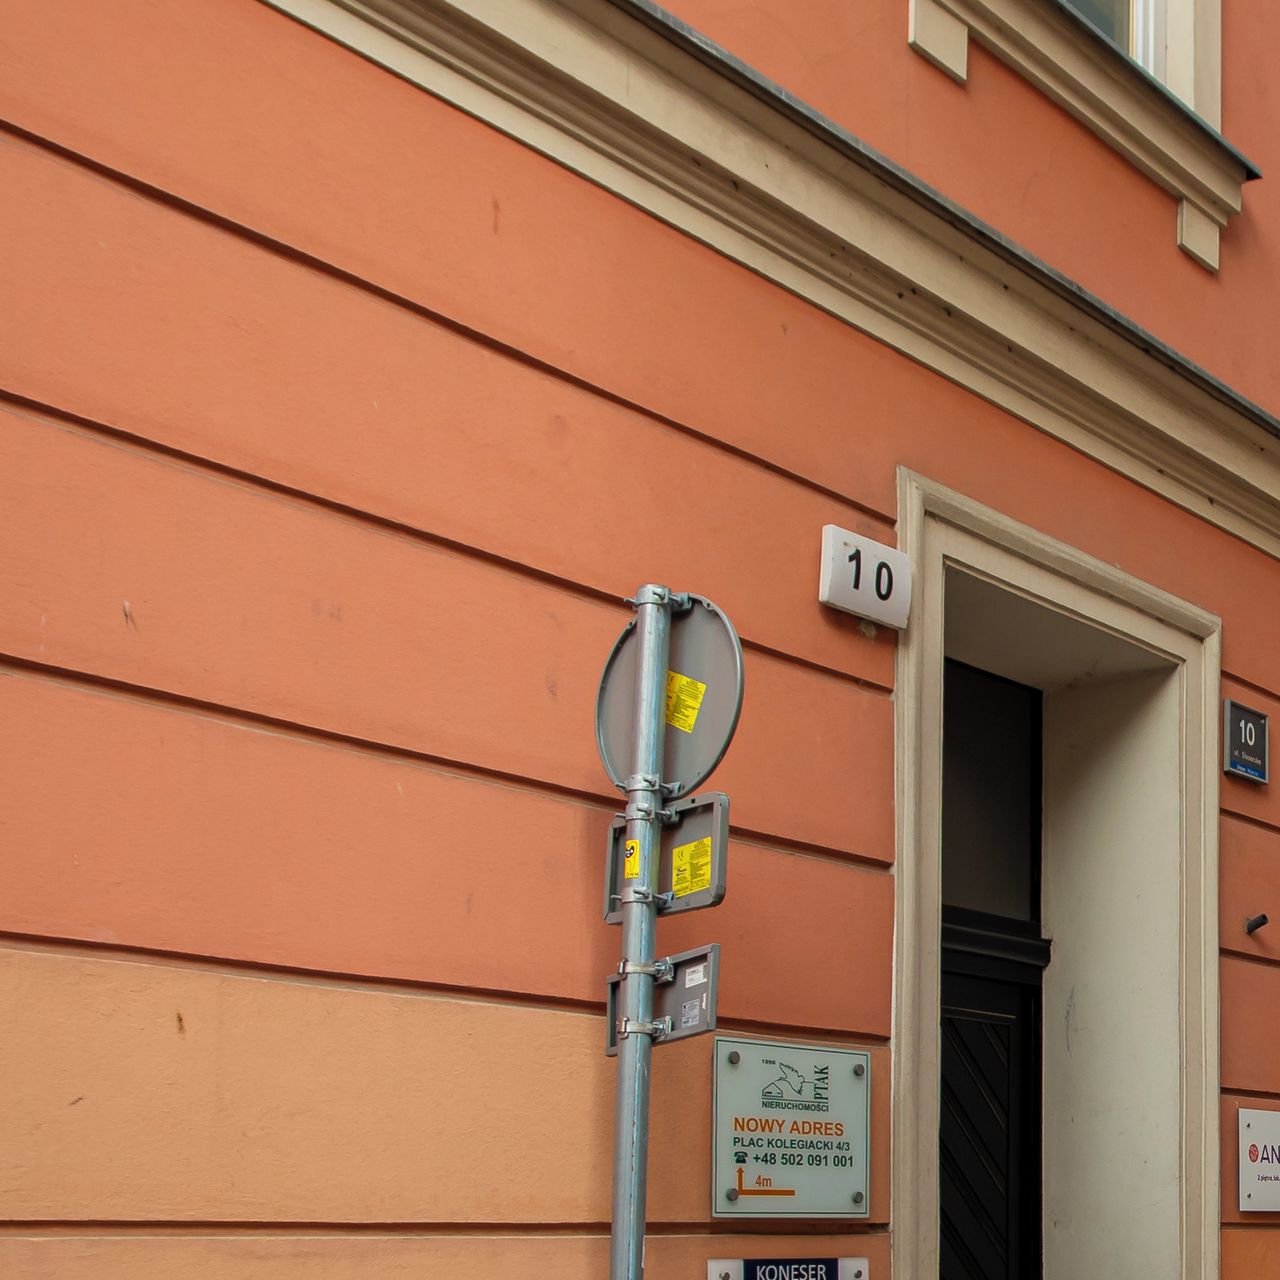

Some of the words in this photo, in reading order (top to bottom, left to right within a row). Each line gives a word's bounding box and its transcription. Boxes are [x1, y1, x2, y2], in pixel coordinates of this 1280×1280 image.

[847, 548, 894, 601] 10
[1239, 719, 1256, 746] 10
[813, 1064, 829, 1101] PTAK
[761, 1100, 829, 1112] NIERUCHOMOŚCI
[733, 1117, 785, 1133] NOWY
[789, 1120, 844, 1137] ADRES
[733, 1137, 764, 1148] PLAC
[767, 1138, 833, 1151] KOLEGIACKI
[836, 1141, 850, 1152] 4/3
[753, 1152, 777, 1166] +48
[781, 1153, 804, 1166] 502
[807, 1154, 828, 1167] 091
[833, 1155, 853, 1167] 001
[755, 1175, 772, 1187] 4m
